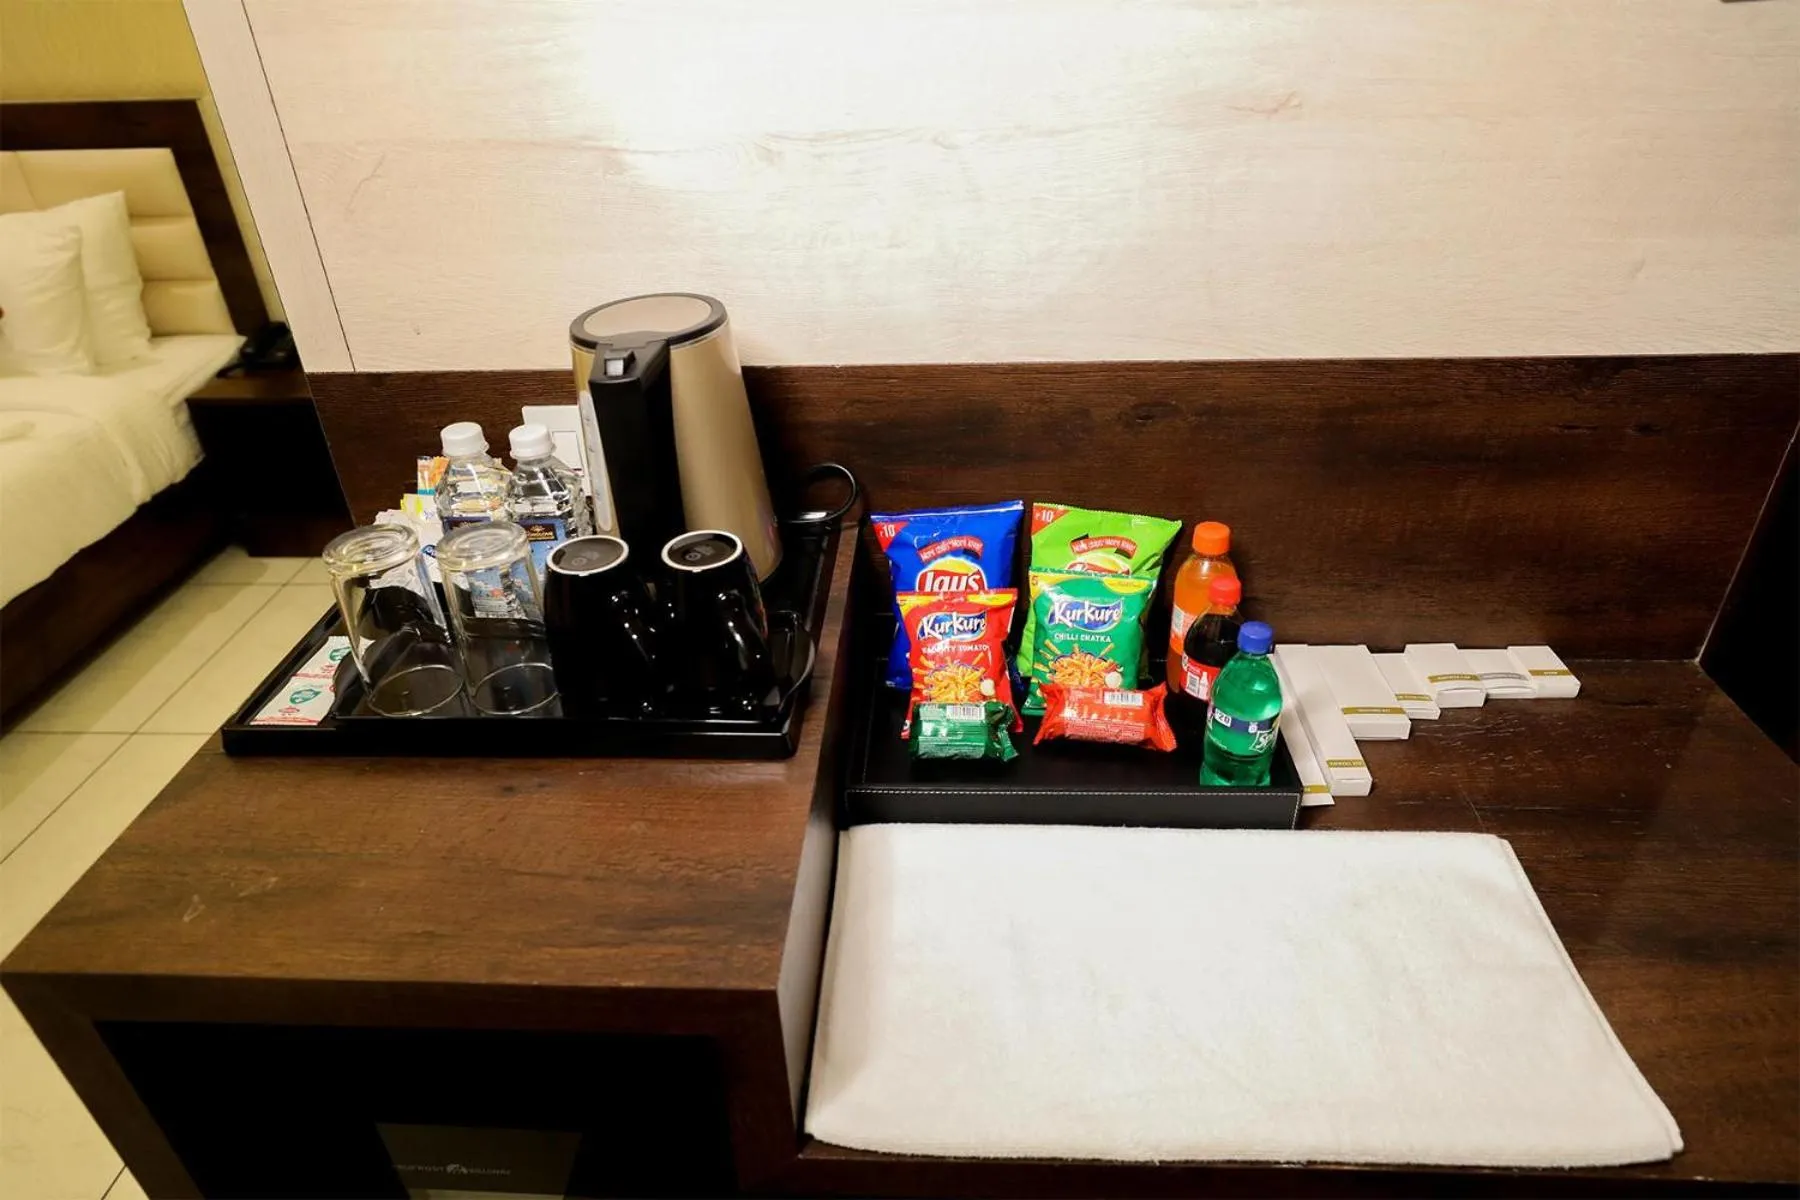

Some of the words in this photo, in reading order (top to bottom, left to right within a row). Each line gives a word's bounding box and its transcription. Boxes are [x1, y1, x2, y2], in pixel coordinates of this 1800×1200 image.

[1053, 600, 1121, 627] Kurkure
[1054, 633, 1079, 642] CHILLI
[1081, 634, 1112, 643] CHATKA
